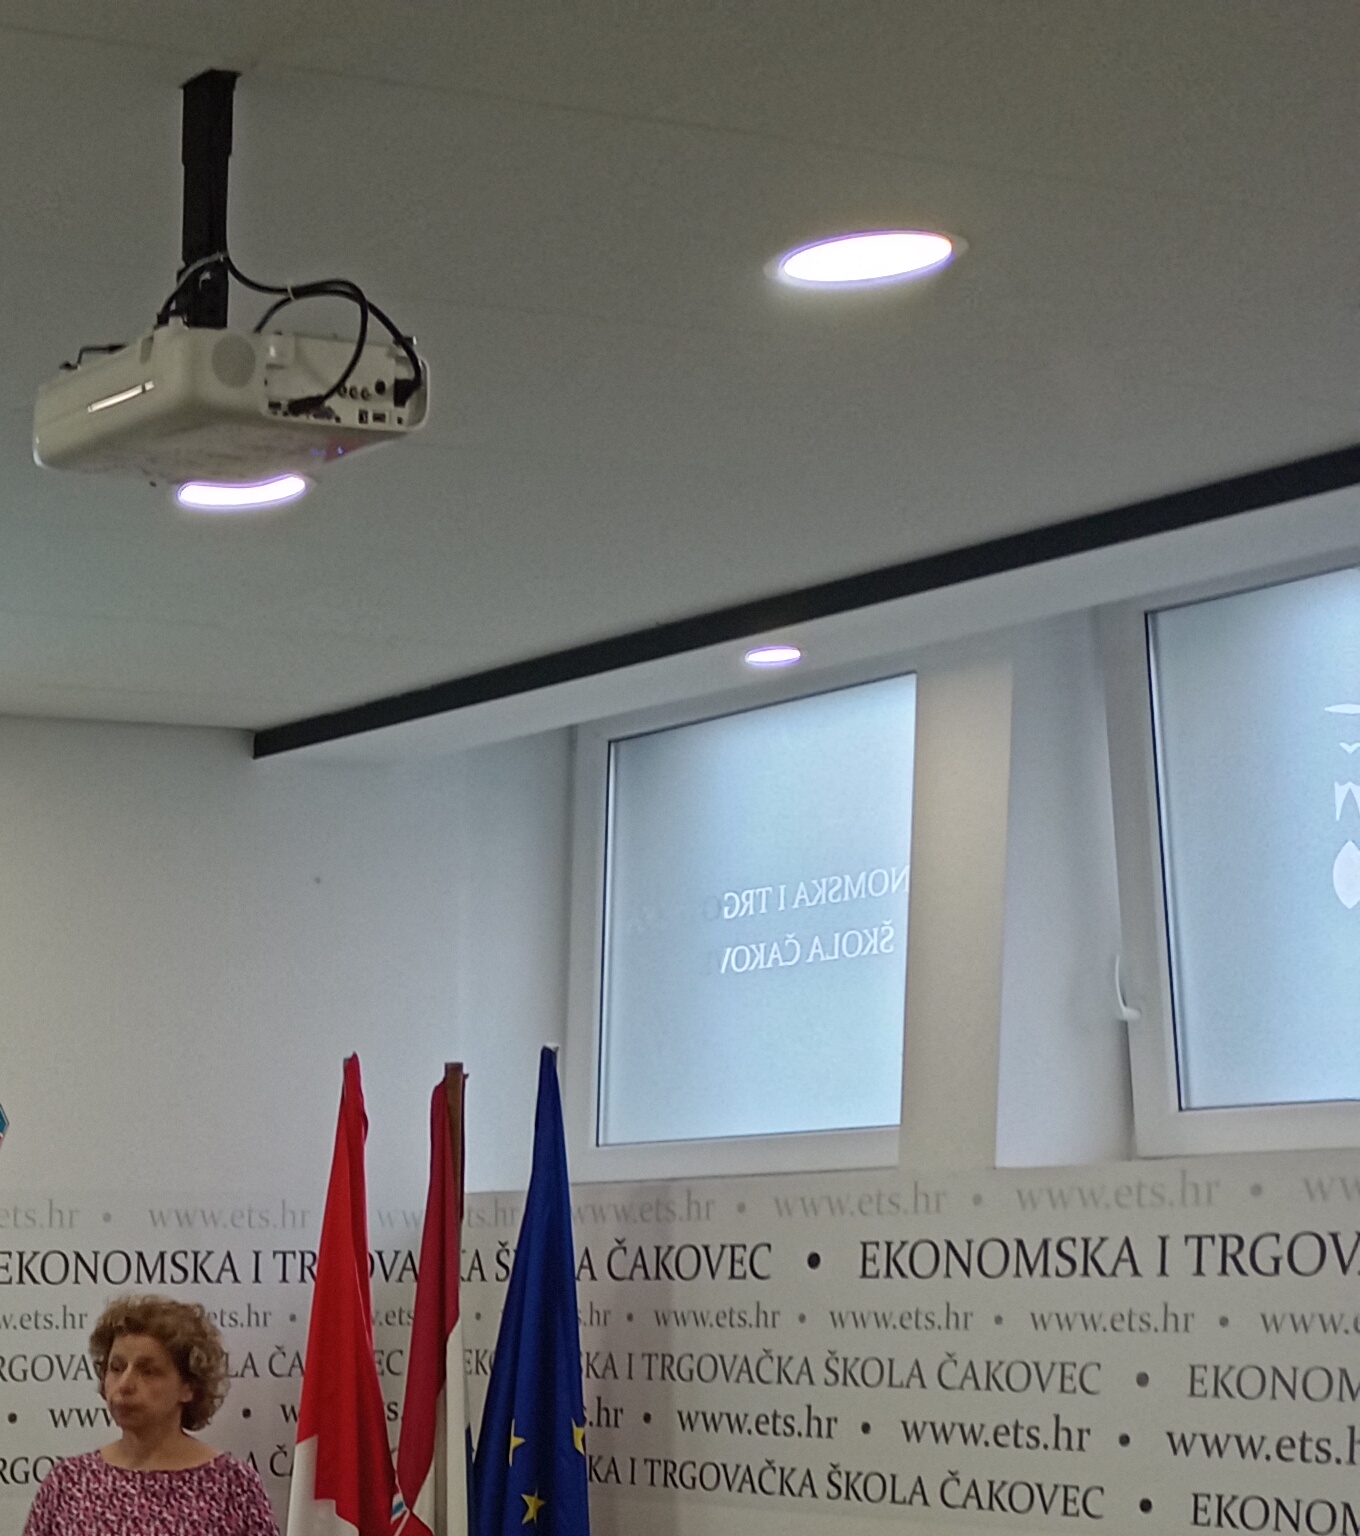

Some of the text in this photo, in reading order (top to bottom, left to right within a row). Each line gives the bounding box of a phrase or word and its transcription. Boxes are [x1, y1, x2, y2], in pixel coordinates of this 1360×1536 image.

[252, 1249, 263, 1285] I
[606, 1238, 772, 1282] ČAKOVEC
[859, 1236, 1143, 1280] EKONOMSKA
[1157, 1234, 1170, 1278] I
[1183, 1230, 1360, 1278] TRGOV
[654, 1301, 781, 1330] www.ets.hr
[830, 1301, 974, 1332] www.ets.hr
[1030, 1301, 1195, 1334] www.ets.hr
[627, 1352, 634, 1380] I
[642, 1348, 816, 1387] TRGOVAČKA
[823, 1350, 928, 1390] ŠKOLA
[936, 1351, 1102, 1396] ČAKOVEC
[677, 1404, 839, 1441] www.ets.hr
[901, 1414, 1091, 1452] www.ets.hr
[629, 1458, 636, 1486] I
[643, 1457, 819, 1499] TRGOVAČKA
[826, 1462, 931, 1508] ŠKOLA
[939, 1470, 1105, 1520] ČAKOVEC
